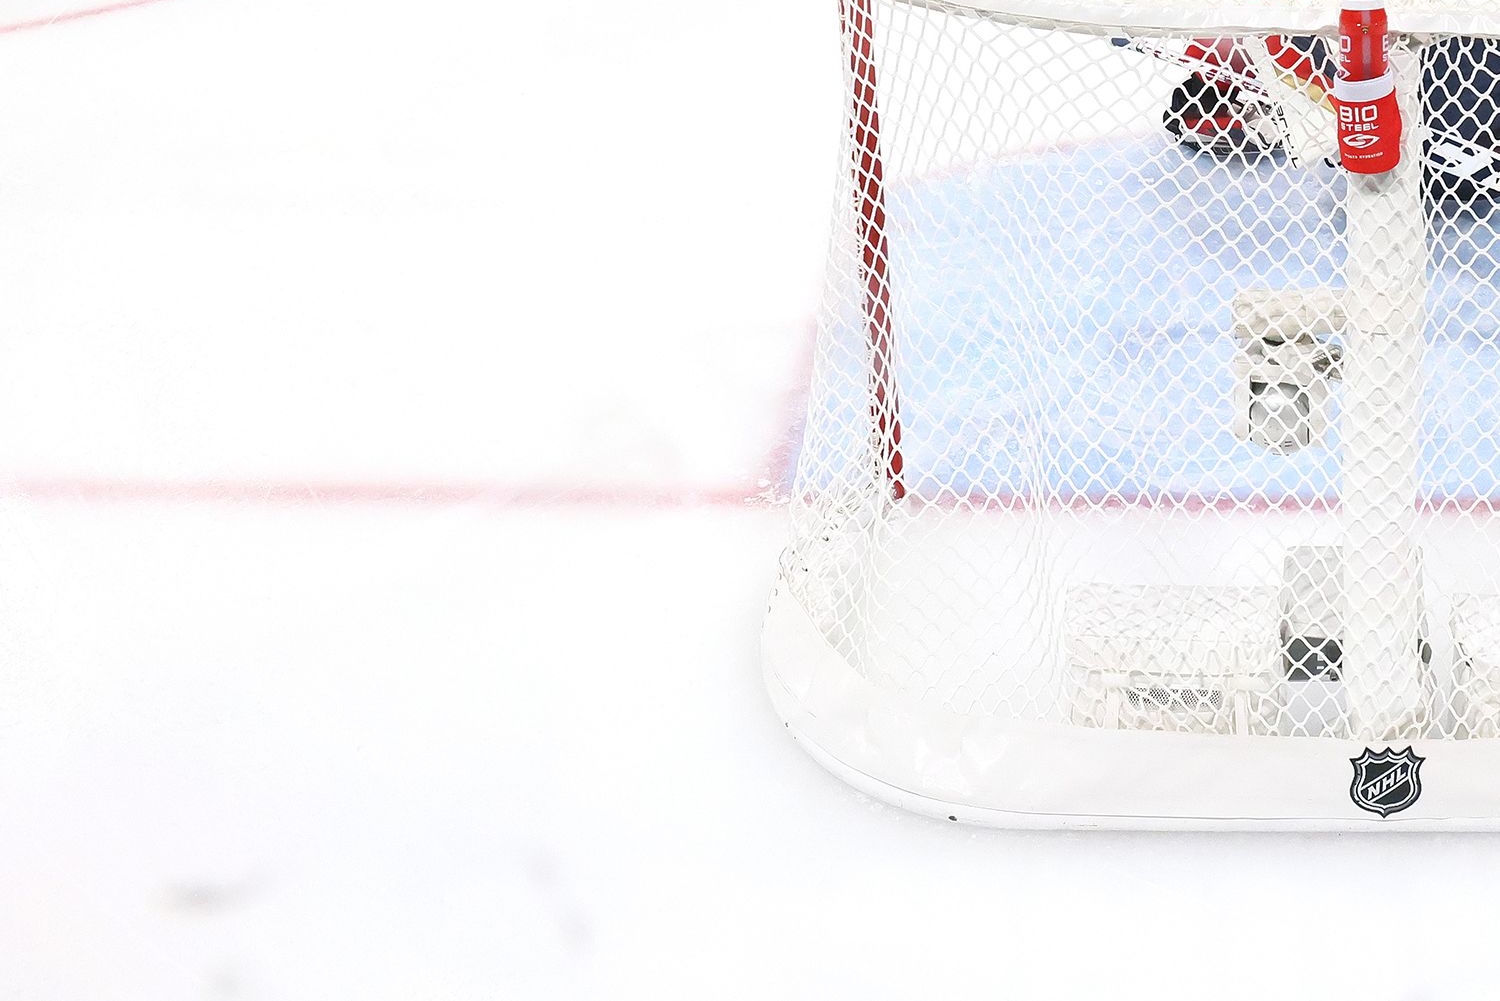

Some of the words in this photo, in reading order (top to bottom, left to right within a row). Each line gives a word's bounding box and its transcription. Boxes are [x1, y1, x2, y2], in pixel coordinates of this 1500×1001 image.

[1339, 103, 1379, 123] BIO
[1340, 122, 1380, 132] STEEL
[1366, 765, 1408, 801] NHL
